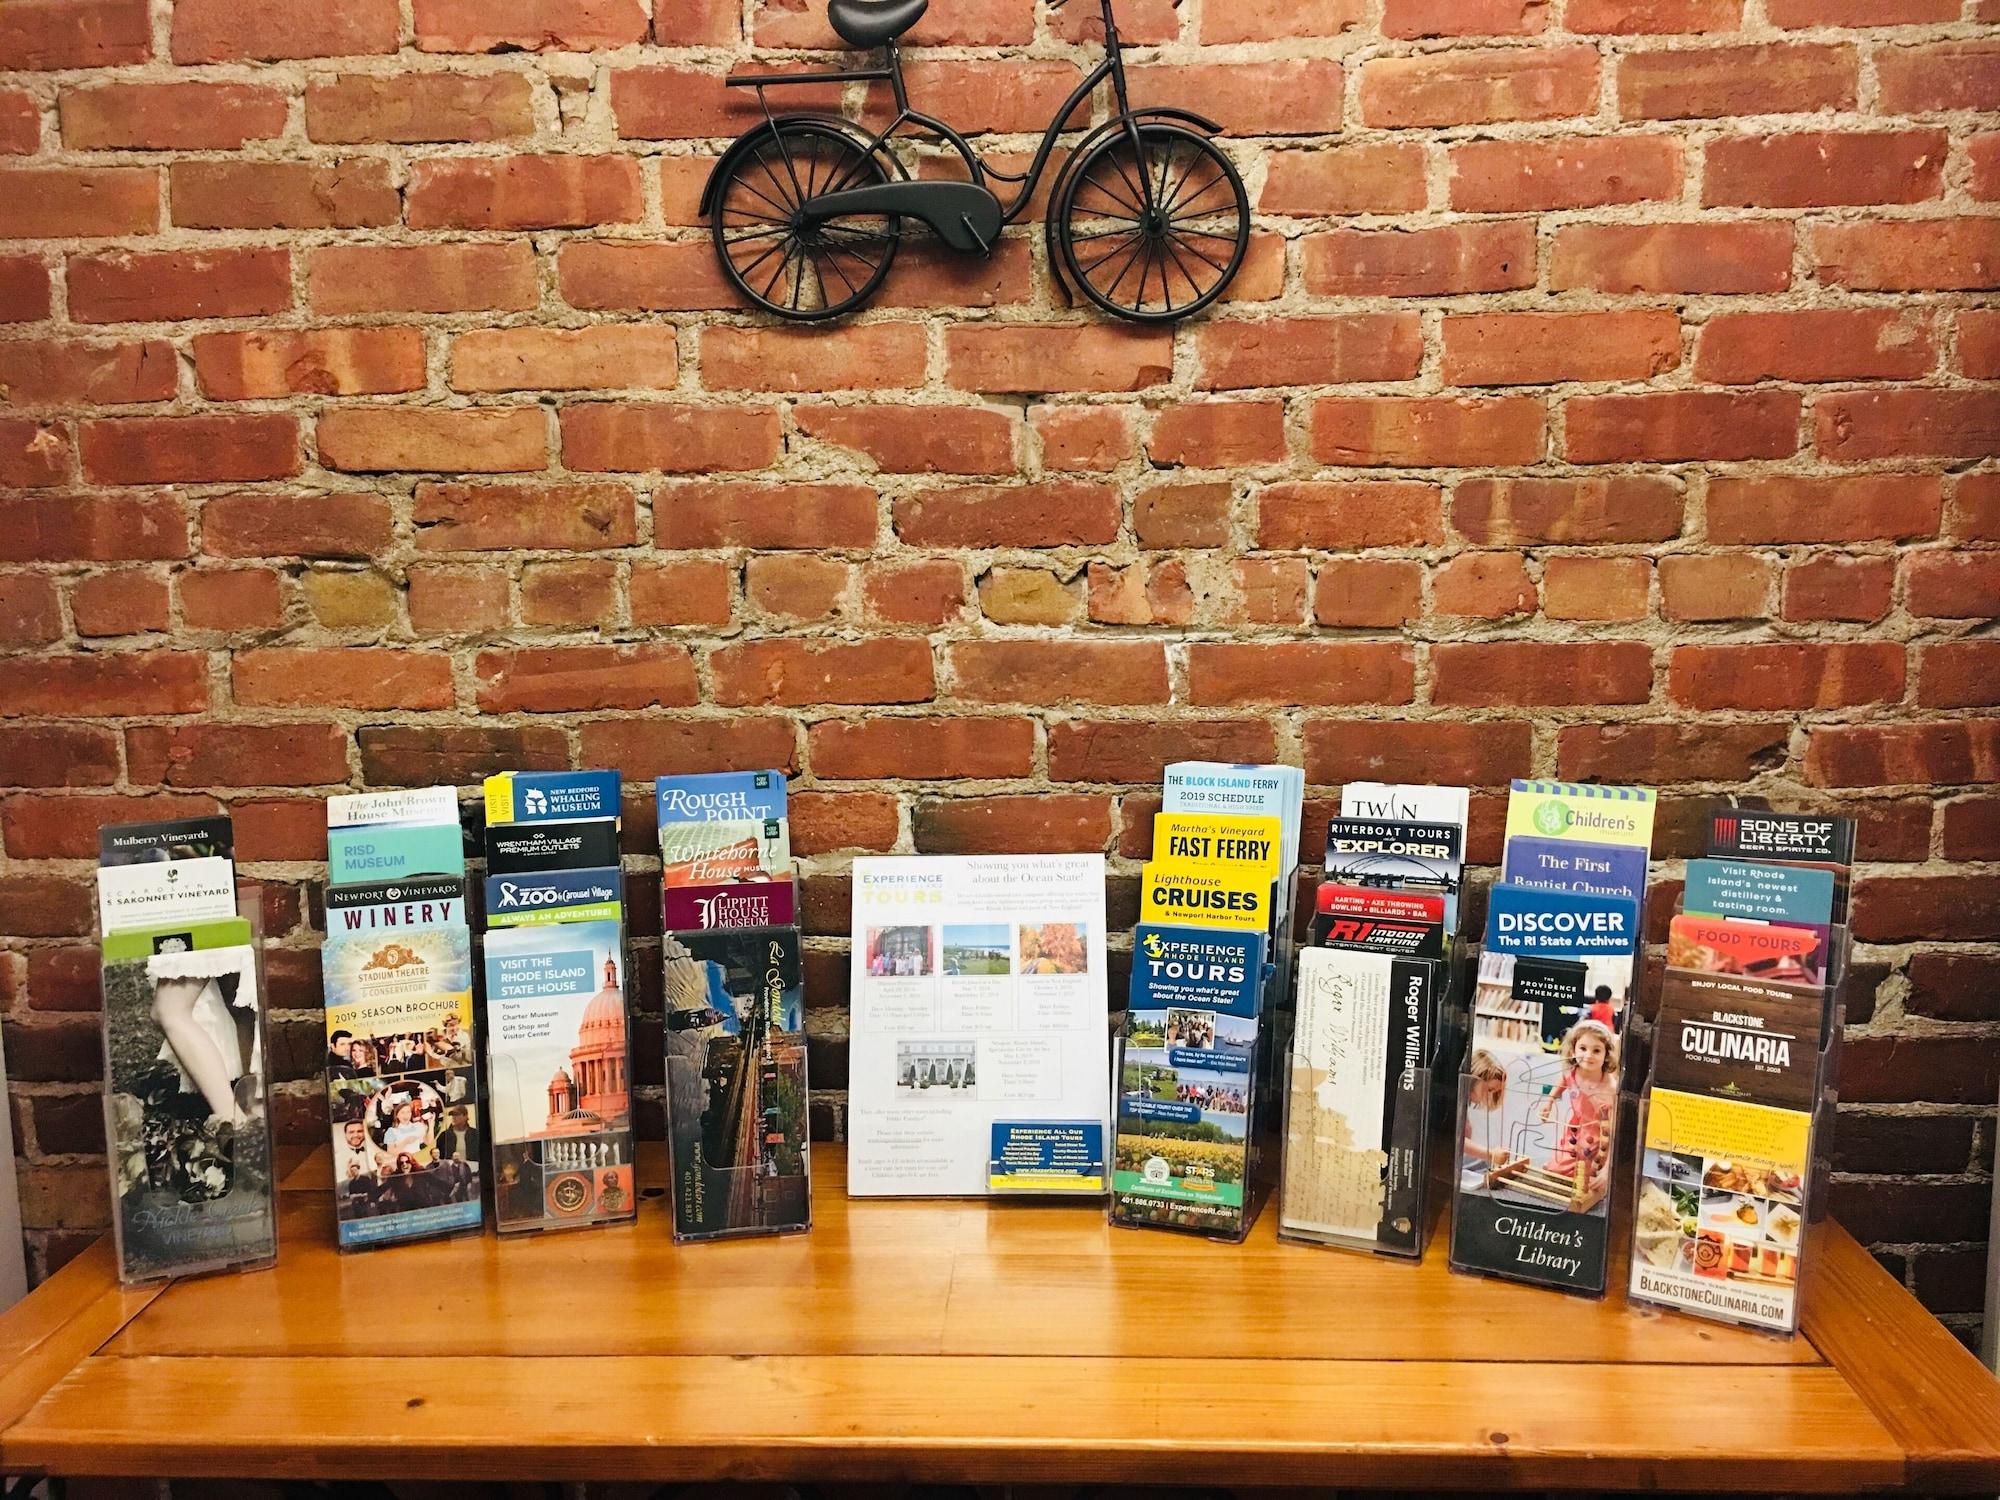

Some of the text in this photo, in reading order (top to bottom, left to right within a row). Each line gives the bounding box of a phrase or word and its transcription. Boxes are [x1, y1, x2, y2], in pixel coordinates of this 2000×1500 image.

[568, 786, 600, 794] BEDFORD
[1168, 776, 1279, 790] THE BLOCK ISLAND FERRY
[350, 800, 369, 811] The
[371, 798, 403, 809] John
[489, 793, 510, 816] VISIT VISIT
[550, 793, 601, 804] WHALING
[1180, 792, 1264, 804] 2019 SCHEDULE
[551, 802, 601, 813] MUSEUM
[707, 805, 772, 821] POINT
[347, 810, 389, 821] House
[1566, 810, 1635, 831] Children's
[1171, 824, 1265, 837] Martha's Vineyard
[1331, 824, 1451, 840] RIVERBOAT TOURS
[1741, 819, 1833, 834] SONS OF
[113, 830, 209, 847] Mulberry Vineyards
[496, 837, 583, 849] WRENTHAM VILLAGE
[1741, 831, 1831, 846] LIBERTY
[344, 845, 375, 857] RISD
[500, 843, 580, 854] PREMIUM OUTLETS
[671, 843, 777, 865] Whitehorne
[1170, 836, 1211, 858] FAST
[1217, 838, 1271, 861] FERRY
[1333, 839, 1450, 860] EXPLORER
[1775, 846, 1813, 854] SPIRITS
[345, 855, 405, 870] MUSEUM
[967, 859, 1089, 872] Showing you what's great
[1538, 854, 1611, 873] The First
[689, 862, 741, 880] House
[972, 872, 1084, 884] about the Ocean State!
[1722, 866, 1786, 881] Visit Rhode
[863, 874, 943, 884] EXPERIENCE
[1154, 874, 1222, 887] Lighthouse
[1707, 877, 1798, 893] Island's newest
[117, 893, 174, 905] SAKONNET
[178, 887, 229, 899] VINEYARD
[334, 885, 457, 902] NEWPORT VINEYARDS
[519, 885, 613, 906] ZOO Carousel Village
[862, 889, 943, 904] TOURS
[1152, 887, 1258, 911] CRUISES
[1721, 889, 1782, 903] distillery &
[718, 896, 769, 909] LIPPITT
[1334, 896, 1424, 910] KARTING AXE THROWING
[1713, 900, 1789, 915] tasting room.
[344, 902, 451, 930] WINERY
[501, 908, 612, 924] ALWAYS AN ADVENTURE!
[719, 906, 769, 919] HOUSE
[1172, 911, 1204, 919] Newport
[1206, 913, 1233, 921] Harbor
[1331, 904, 1427, 918] BOWLING BILLIARDS BAR
[719, 917, 769, 928] MUSEUM
[1499, 912, 1624, 932] DISCOVER
[1327, 920, 1426, 941] RI INDOOR
[1697, 930, 1741, 945] FOOD
[1149, 940, 1246, 957] EXPERIENCE
[1324, 941, 1416, 954] ENTERTAINMENT CENTER
[1366, 935, 1421, 947] KARTING
[1498, 935, 1629, 947] The RI State Archives
[1750, 935, 1801, 951] TOURS
[500, 957, 552, 970] VISIT THE
[1164, 952, 1245, 964] RHODE ISLAND
[358, 971, 394, 983] STADIUM
[396, 966, 430, 978] THEATRE
[501, 967, 586, 982] RHODE ISLAND
[1148, 961, 1245, 983] TOURS
[369, 983, 428, 997] CONSERVATORY
[501, 981, 577, 996] STATE HOUSE
[1148, 982, 1240, 998] Showing you what's great
[1520, 980, 1577, 993] PROVIDENCE
[1691, 980, 1793, 1000] ENJOY LOCAL FOOD TOURS!
[1153, 992, 1234, 1006] about the Ocean State!
[335, 1011, 357, 1024] 2019
[361, 1005, 402, 1019] SEASON
[406, 1000, 460, 1013] BROCHURE
[502, 1010, 559, 1021] Charter Museum
[502, 1024, 516, 1032] Gift
[518, 1022, 535, 1032] Shop
[1712, 1011, 1764, 1029] BLACKSTONE
[503, 1030, 551, 1040] Visitor Center
[1403, 976, 1423, 1091] Roger Williams
[1681, 1026, 1790, 1067] CULINARIA
[1685, 1053, 1721, 1064] FOOD TOURS
[1185, 1165, 1215, 1178] STARS
[1495, 1217, 1583, 1248] Children's
[1516, 1244, 1581, 1277] Library
